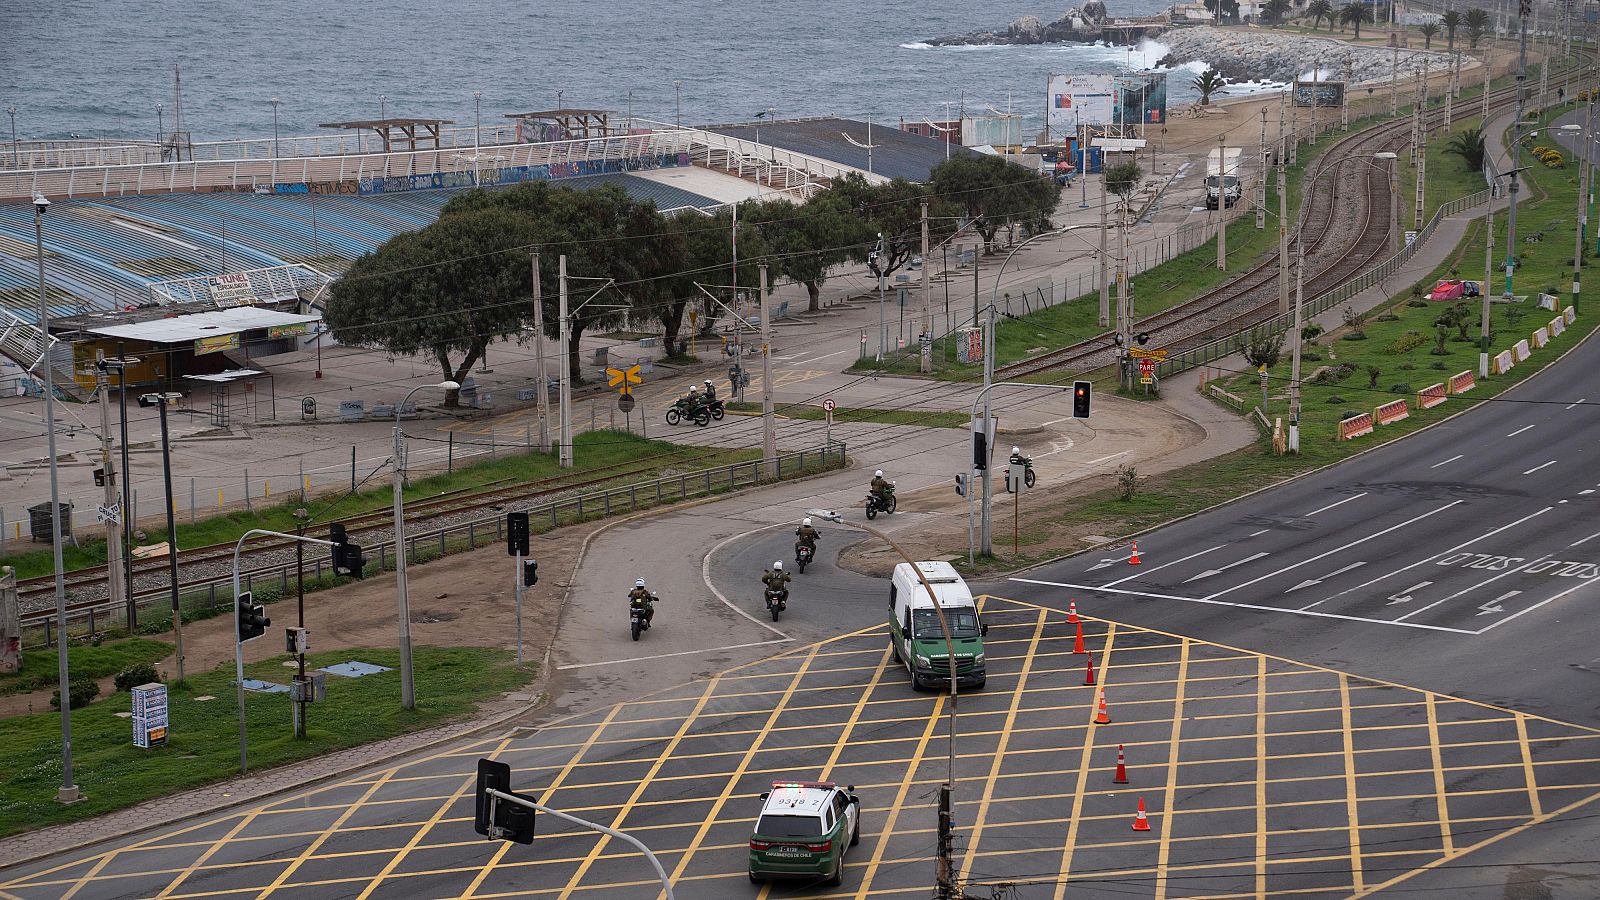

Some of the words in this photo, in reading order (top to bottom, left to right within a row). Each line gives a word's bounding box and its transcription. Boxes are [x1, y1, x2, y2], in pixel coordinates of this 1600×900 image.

[209, 277, 220, 286] EL
[220, 274, 248, 283] TUNEL
[99, 506, 117, 520] CRUCE
